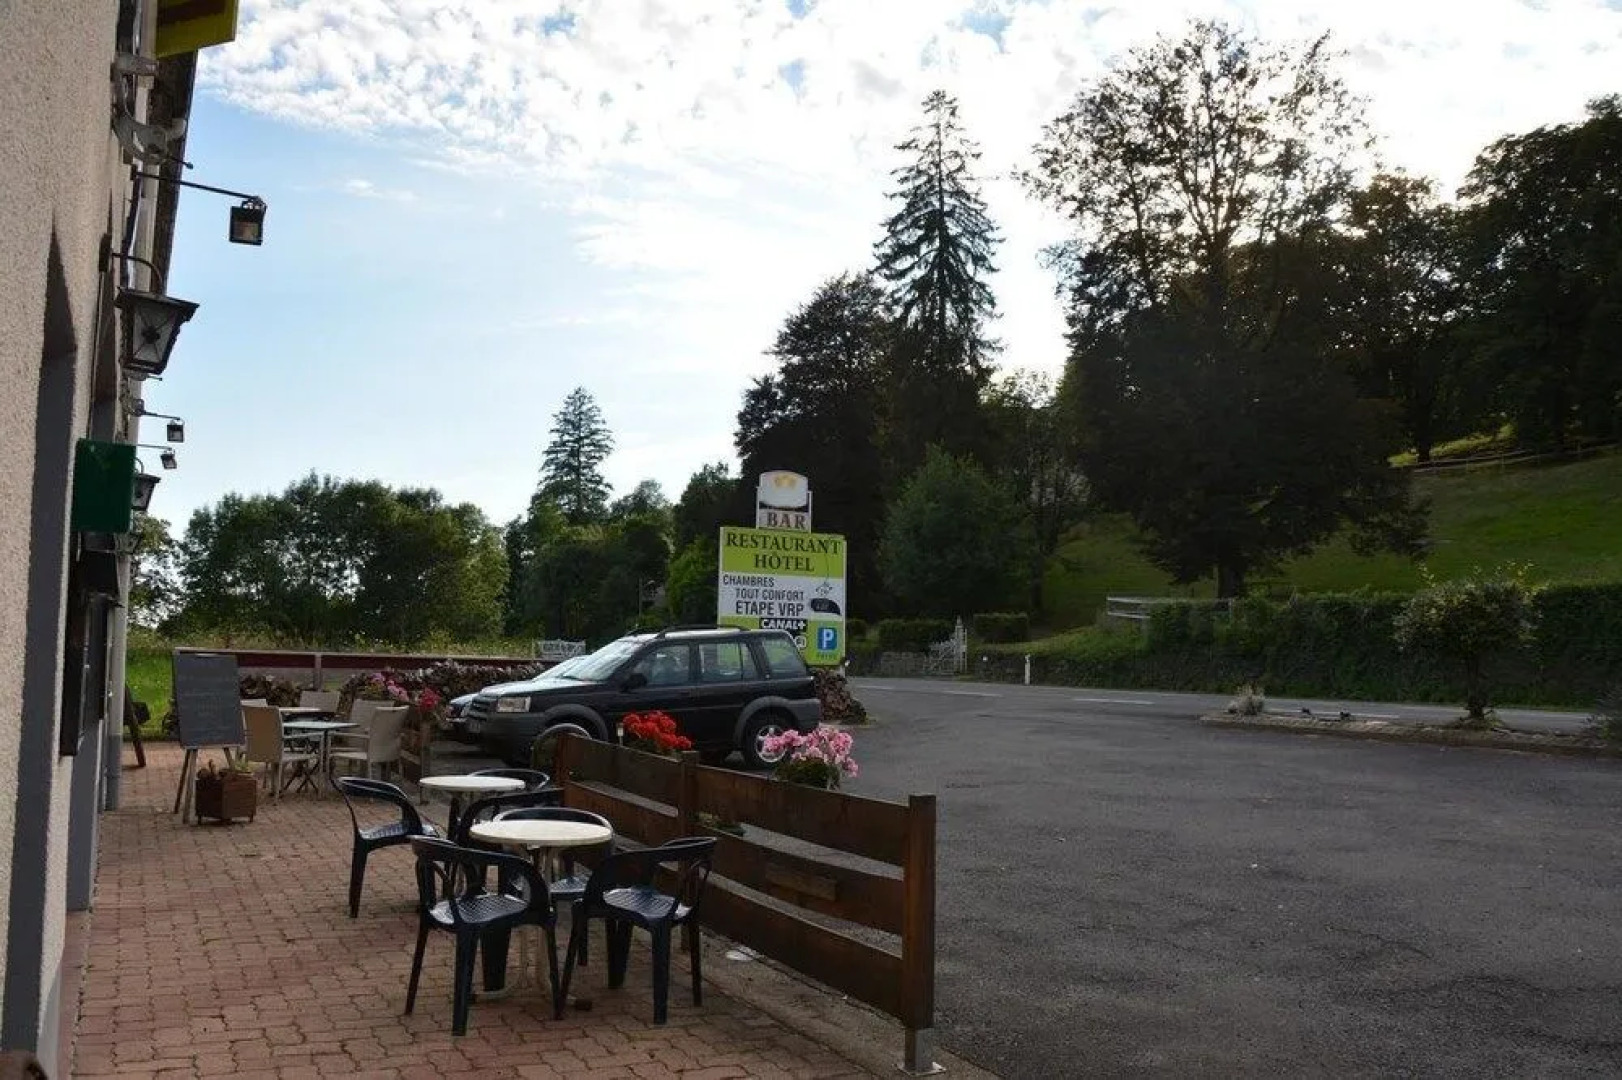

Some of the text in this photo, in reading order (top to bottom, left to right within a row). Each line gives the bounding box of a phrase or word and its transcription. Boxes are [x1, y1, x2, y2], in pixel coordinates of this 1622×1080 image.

[766, 512, 806, 529] BAR
[726, 532, 841, 555] RESTAURANT
[755, 551, 815, 572] HÔTEL
[722, 574, 775, 587] CHAMBRES
[735, 588, 804, 601] TOUT CONFORT
[778, 602, 804, 617] VRP
[761, 618, 806, 630] CANAL+
[822, 628, 835, 649] P
